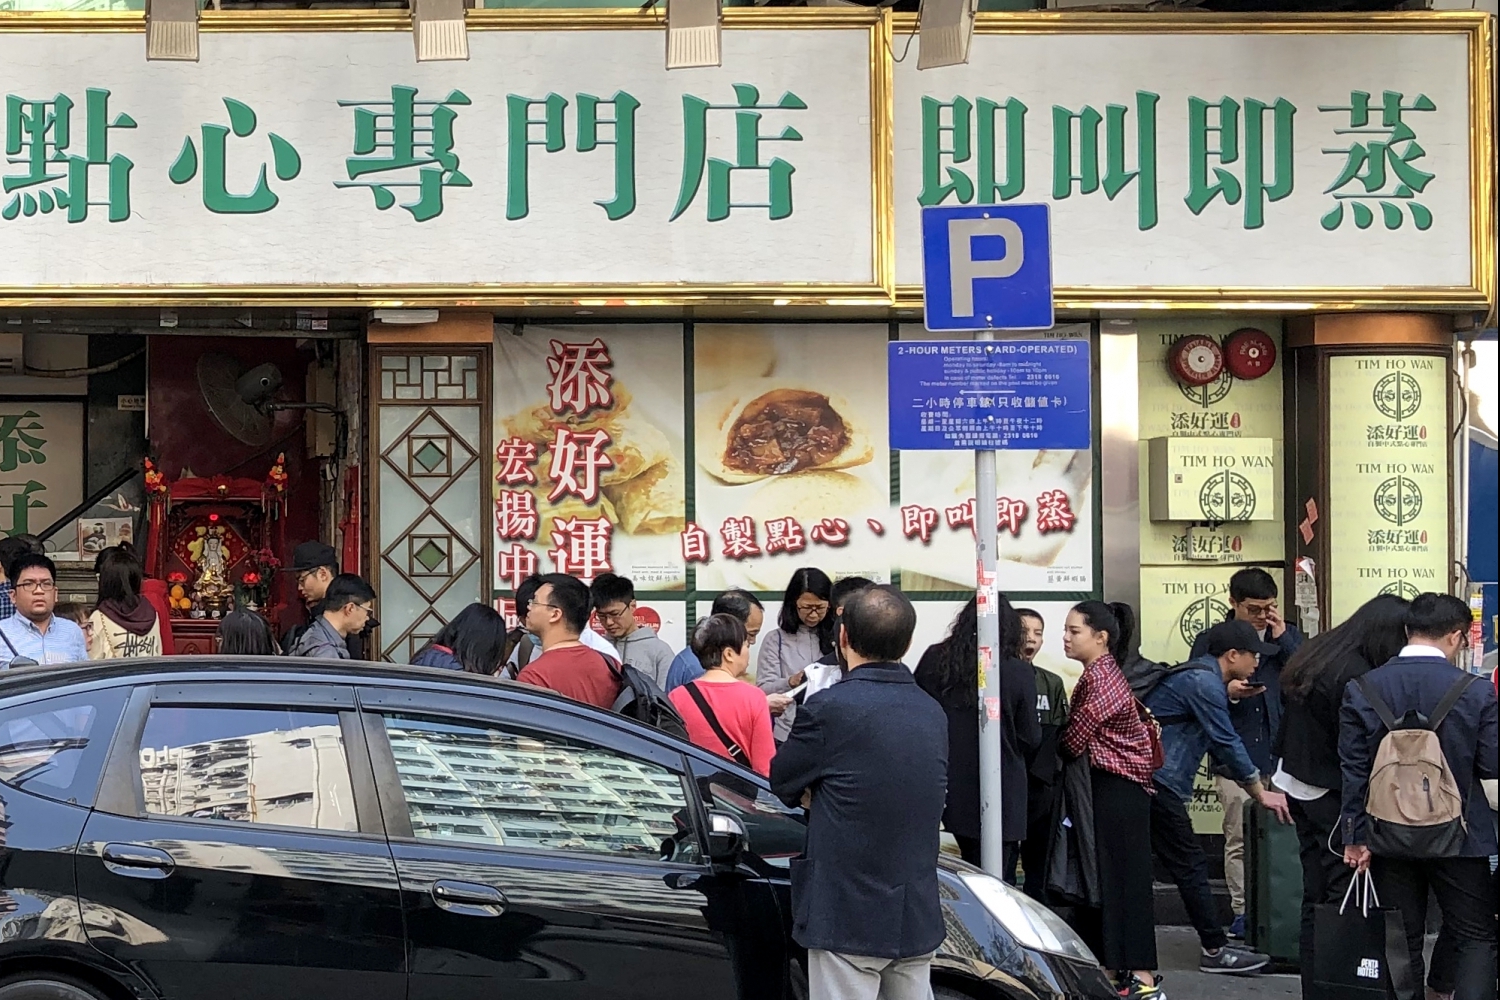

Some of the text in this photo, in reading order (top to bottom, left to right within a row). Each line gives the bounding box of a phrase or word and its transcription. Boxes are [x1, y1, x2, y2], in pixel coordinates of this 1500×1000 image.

[917, 90, 1437, 231] 即叫即蒸
[948, 217, 1025, 319] P
[898, 346, 938, 355] 2-HOUR
[941, 346, 982, 355] METERS
[1355, 360, 1433, 369] TIM HO WAN
[1170, 412, 1230, 430] 添好運
[1366, 425, 1419, 440] 添好運
[547, 338, 612, 580] 添好運
[1180, 456, 1273, 468] TIM HO WAN
[1356, 464, 1434, 473] TIM HO WAN
[1367, 529, 1420, 545] 添好運
[1357, 568, 1435, 578] TIM HO WAN
[1163, 583, 1188, 594] TIM
[1194, 583, 1216, 594] HO
[1357, 966, 1379, 979] HOTELS
